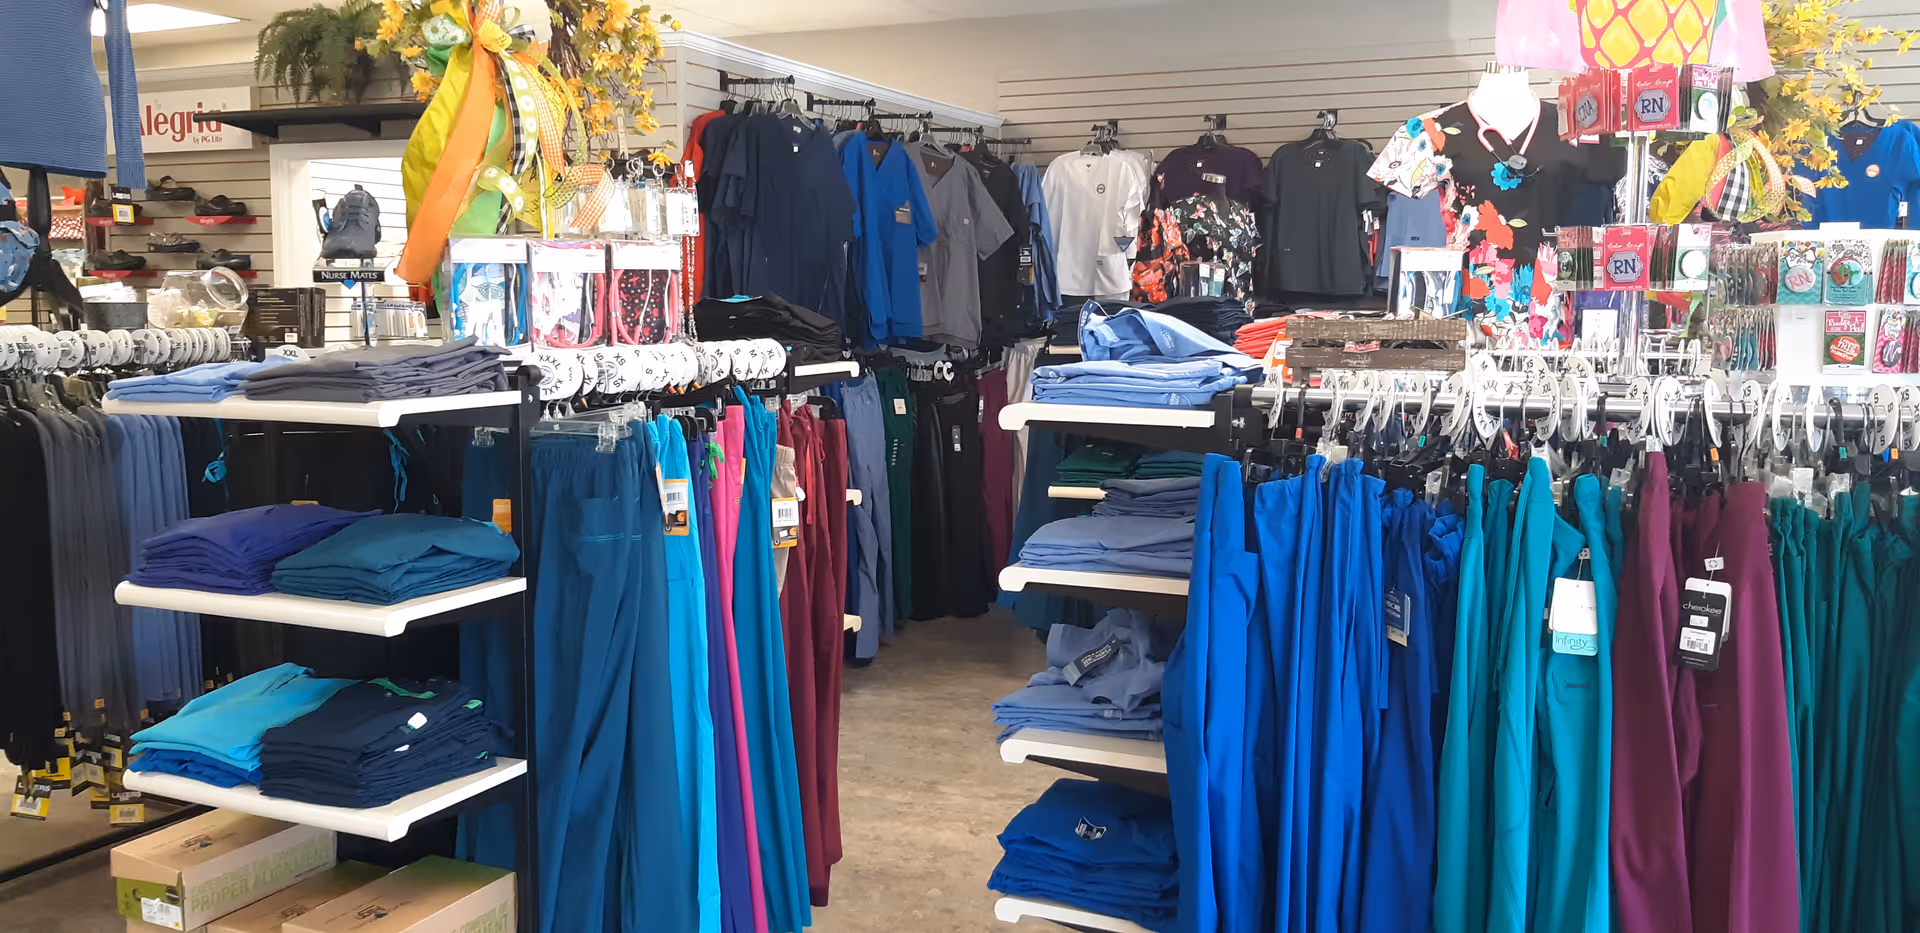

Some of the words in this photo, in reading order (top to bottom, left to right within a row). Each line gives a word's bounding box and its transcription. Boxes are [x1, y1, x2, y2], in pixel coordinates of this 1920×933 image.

[1640, 97, 1664, 115] RN
[1613, 258, 1637, 275] RN
[1787, 271, 1812, 289] RN
[283, 348, 299, 358] XXL
[613, 352, 627, 366] XS
[538, 354, 562, 371] XXXL
[1479, 360, 1489, 372] M
[1629, 384, 1639, 399] XS
[1742, 385, 1752, 399] XS
[1873, 392, 1880, 404] S
[1900, 388, 1911, 403] XS
[1682, 600, 1722, 615] cherokee
[1555, 635, 1589, 648] Infinity
